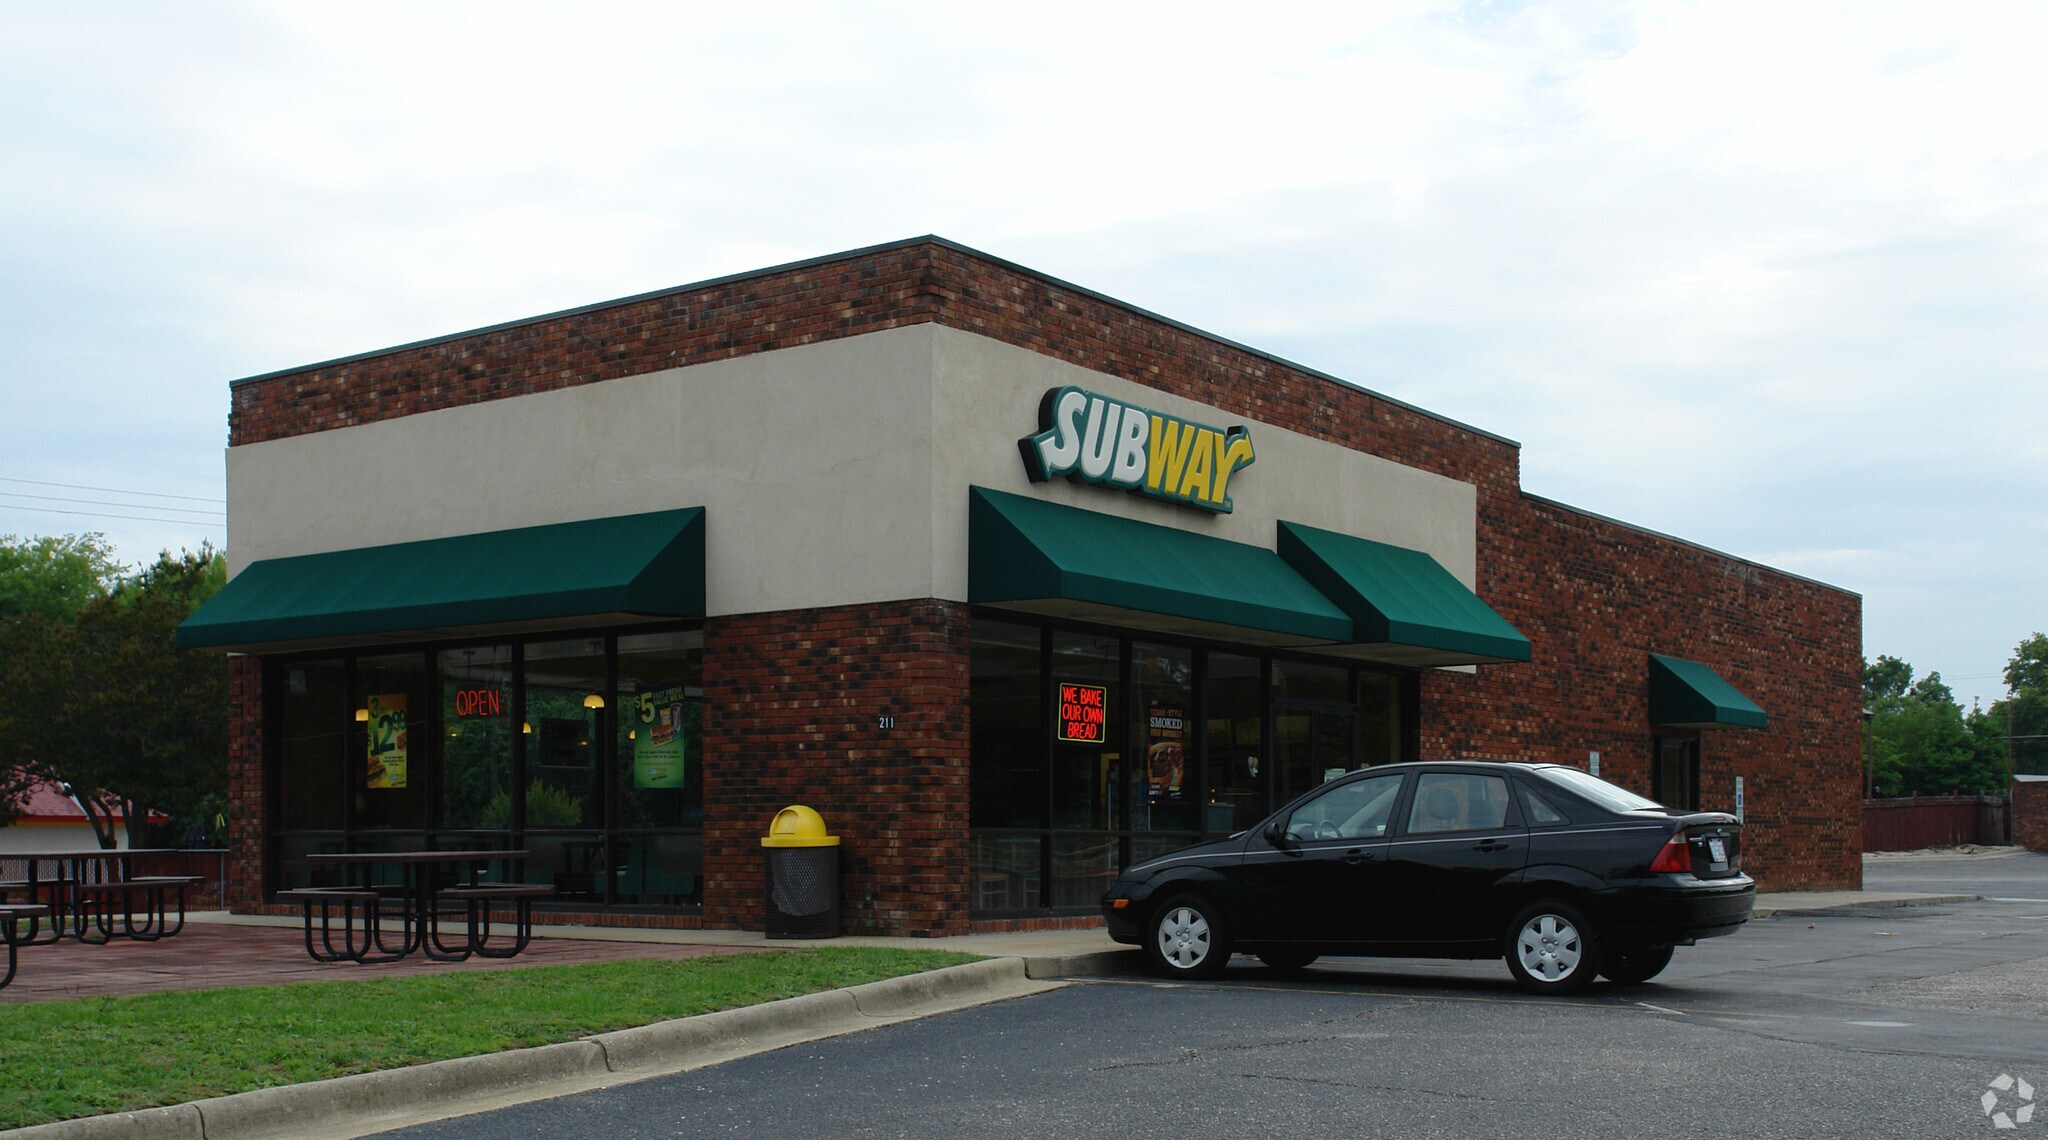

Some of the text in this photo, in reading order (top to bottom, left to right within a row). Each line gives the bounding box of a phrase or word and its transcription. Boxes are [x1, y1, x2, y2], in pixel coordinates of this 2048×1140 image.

[1039, 391, 1255, 505] SUBWAY
[456, 688, 500, 717] OPEN
[1062, 686, 1102, 706] WE BAKE
[879, 716, 894, 729] 211
[1062, 703, 1103, 724] OUR OWN
[1150, 717, 1183, 730] SMOKED
[1067, 721, 1098, 739] BREAD
